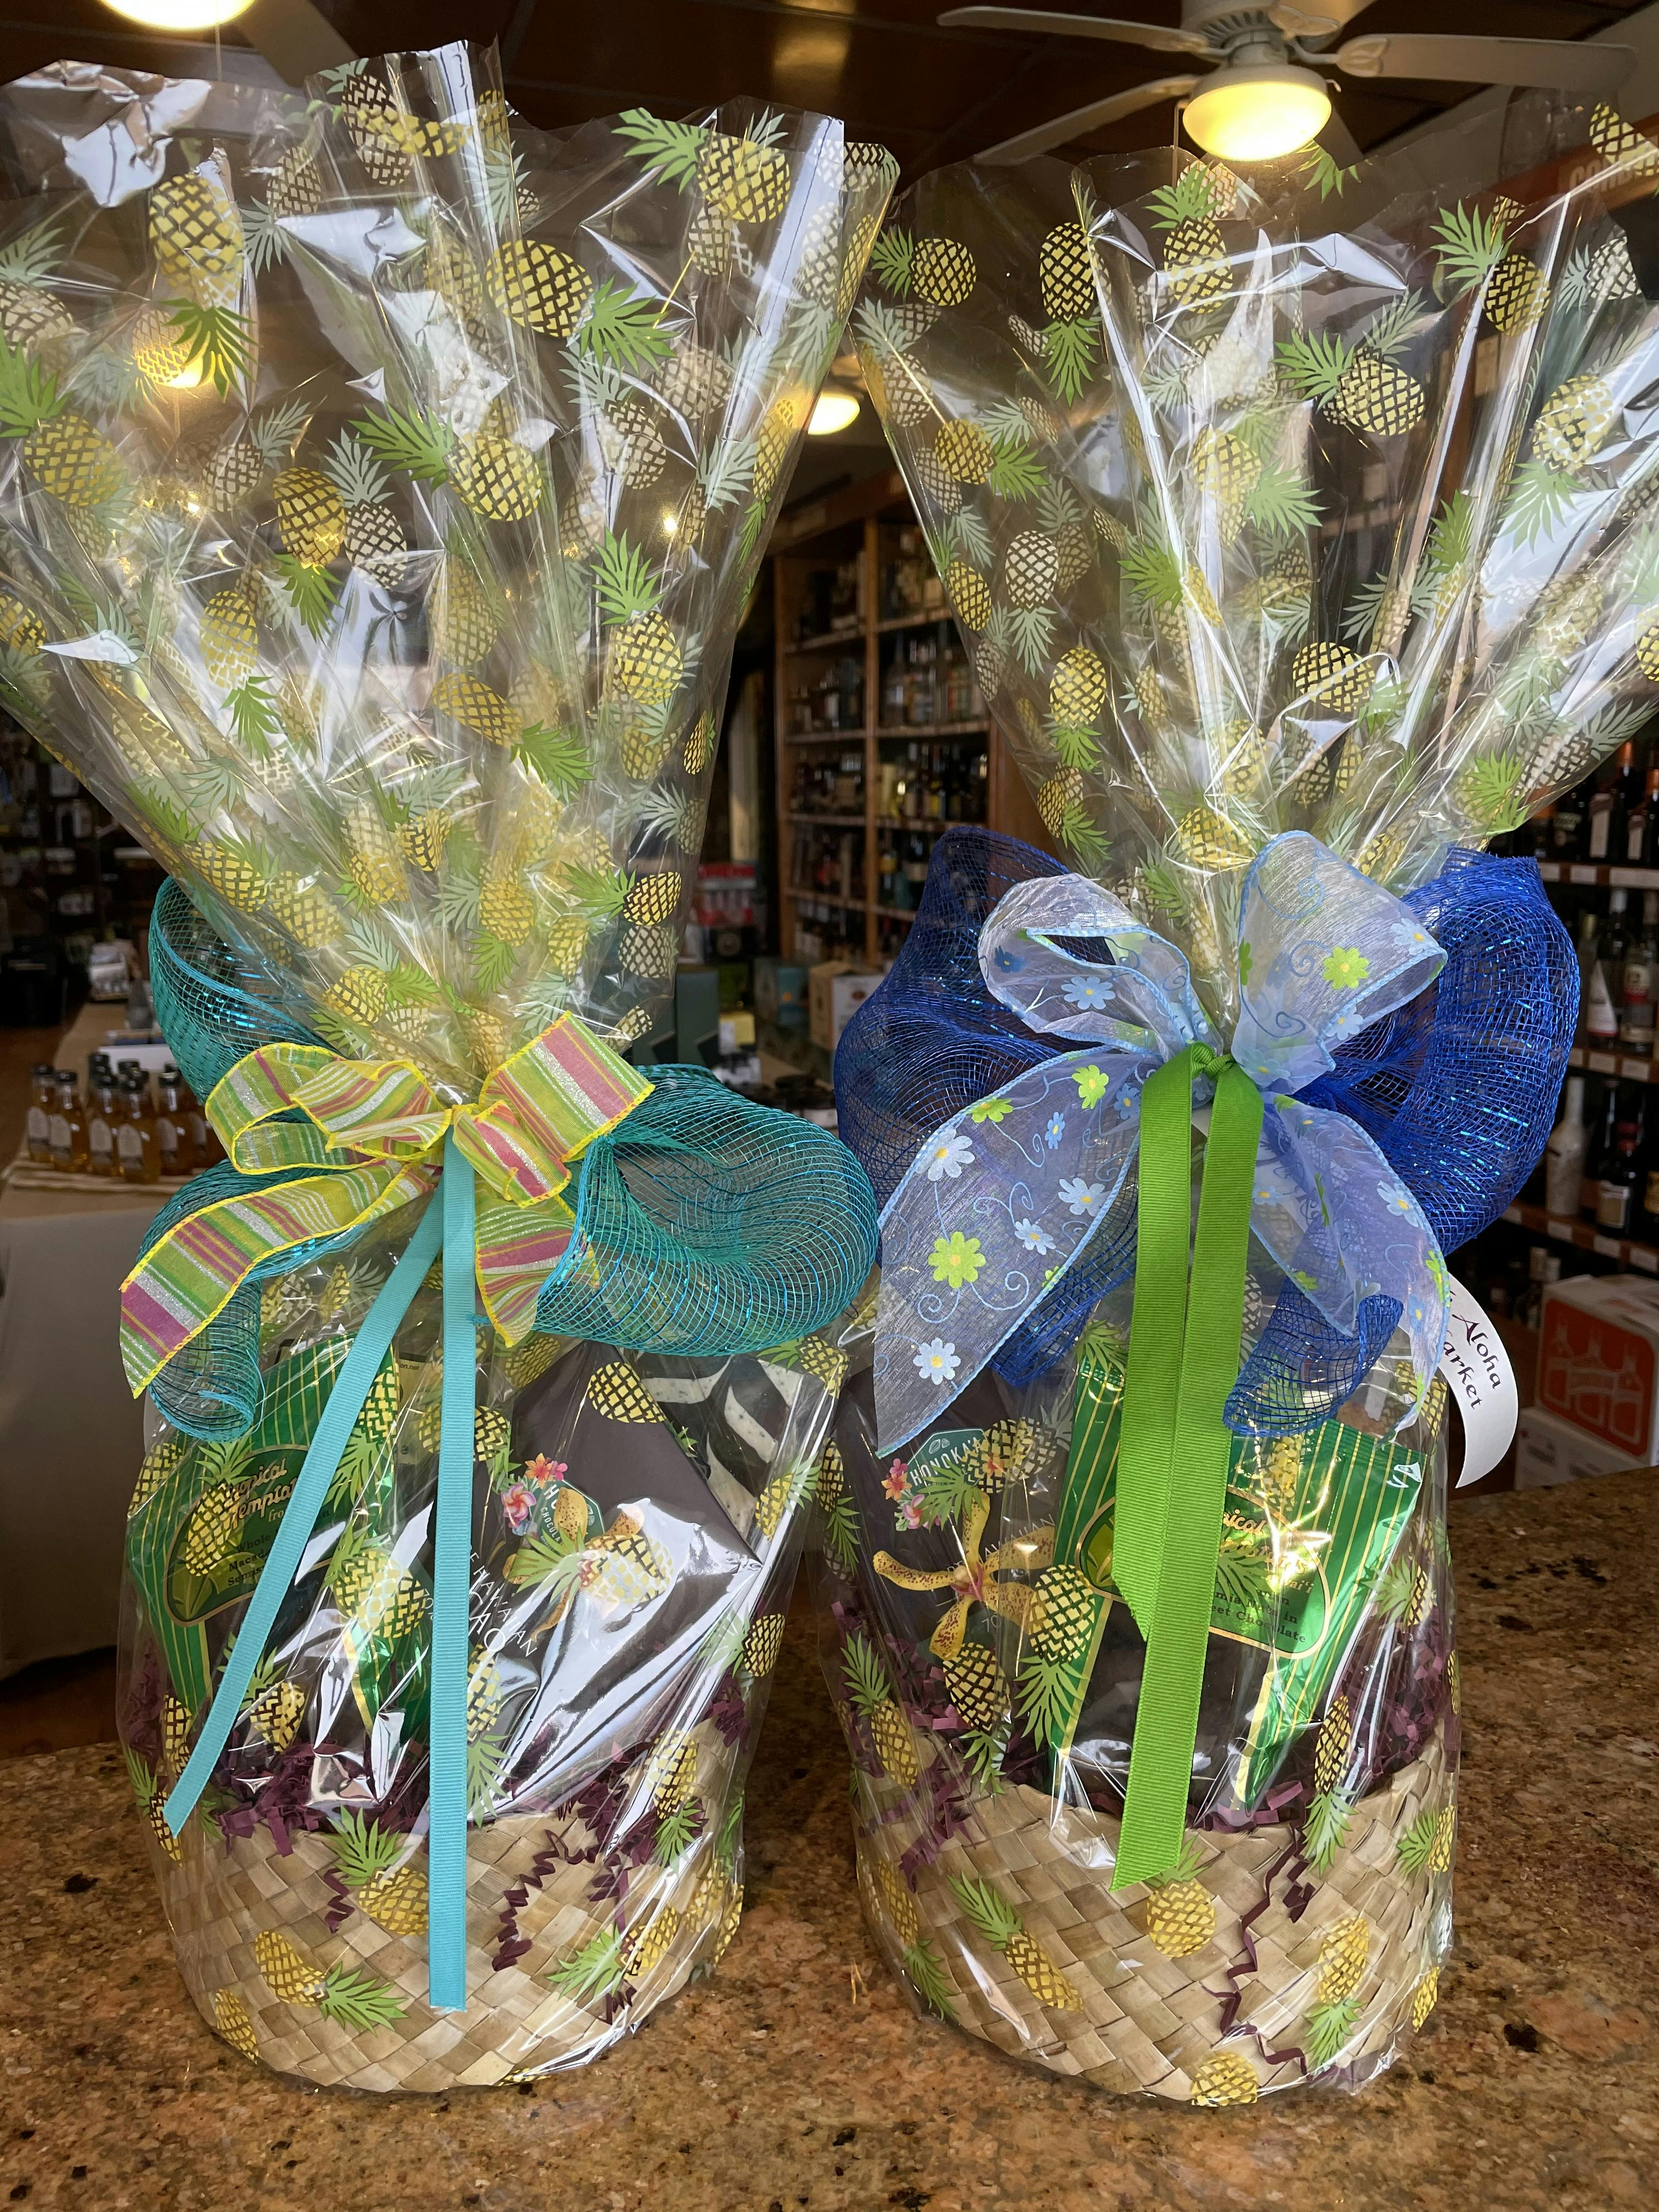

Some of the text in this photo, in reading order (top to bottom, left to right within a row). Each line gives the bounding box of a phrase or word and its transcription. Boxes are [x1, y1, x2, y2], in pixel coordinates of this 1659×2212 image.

[1443, 1330, 1483, 1409] arket
[1451, 1314, 1501, 1390] Aloha
[268, 1509, 284, 1522] fro
[540, 1506, 563, 1545] CHOCOLA
[422, 1588, 433, 1621] 70
[1284, 1611, 1297, 1624] in
